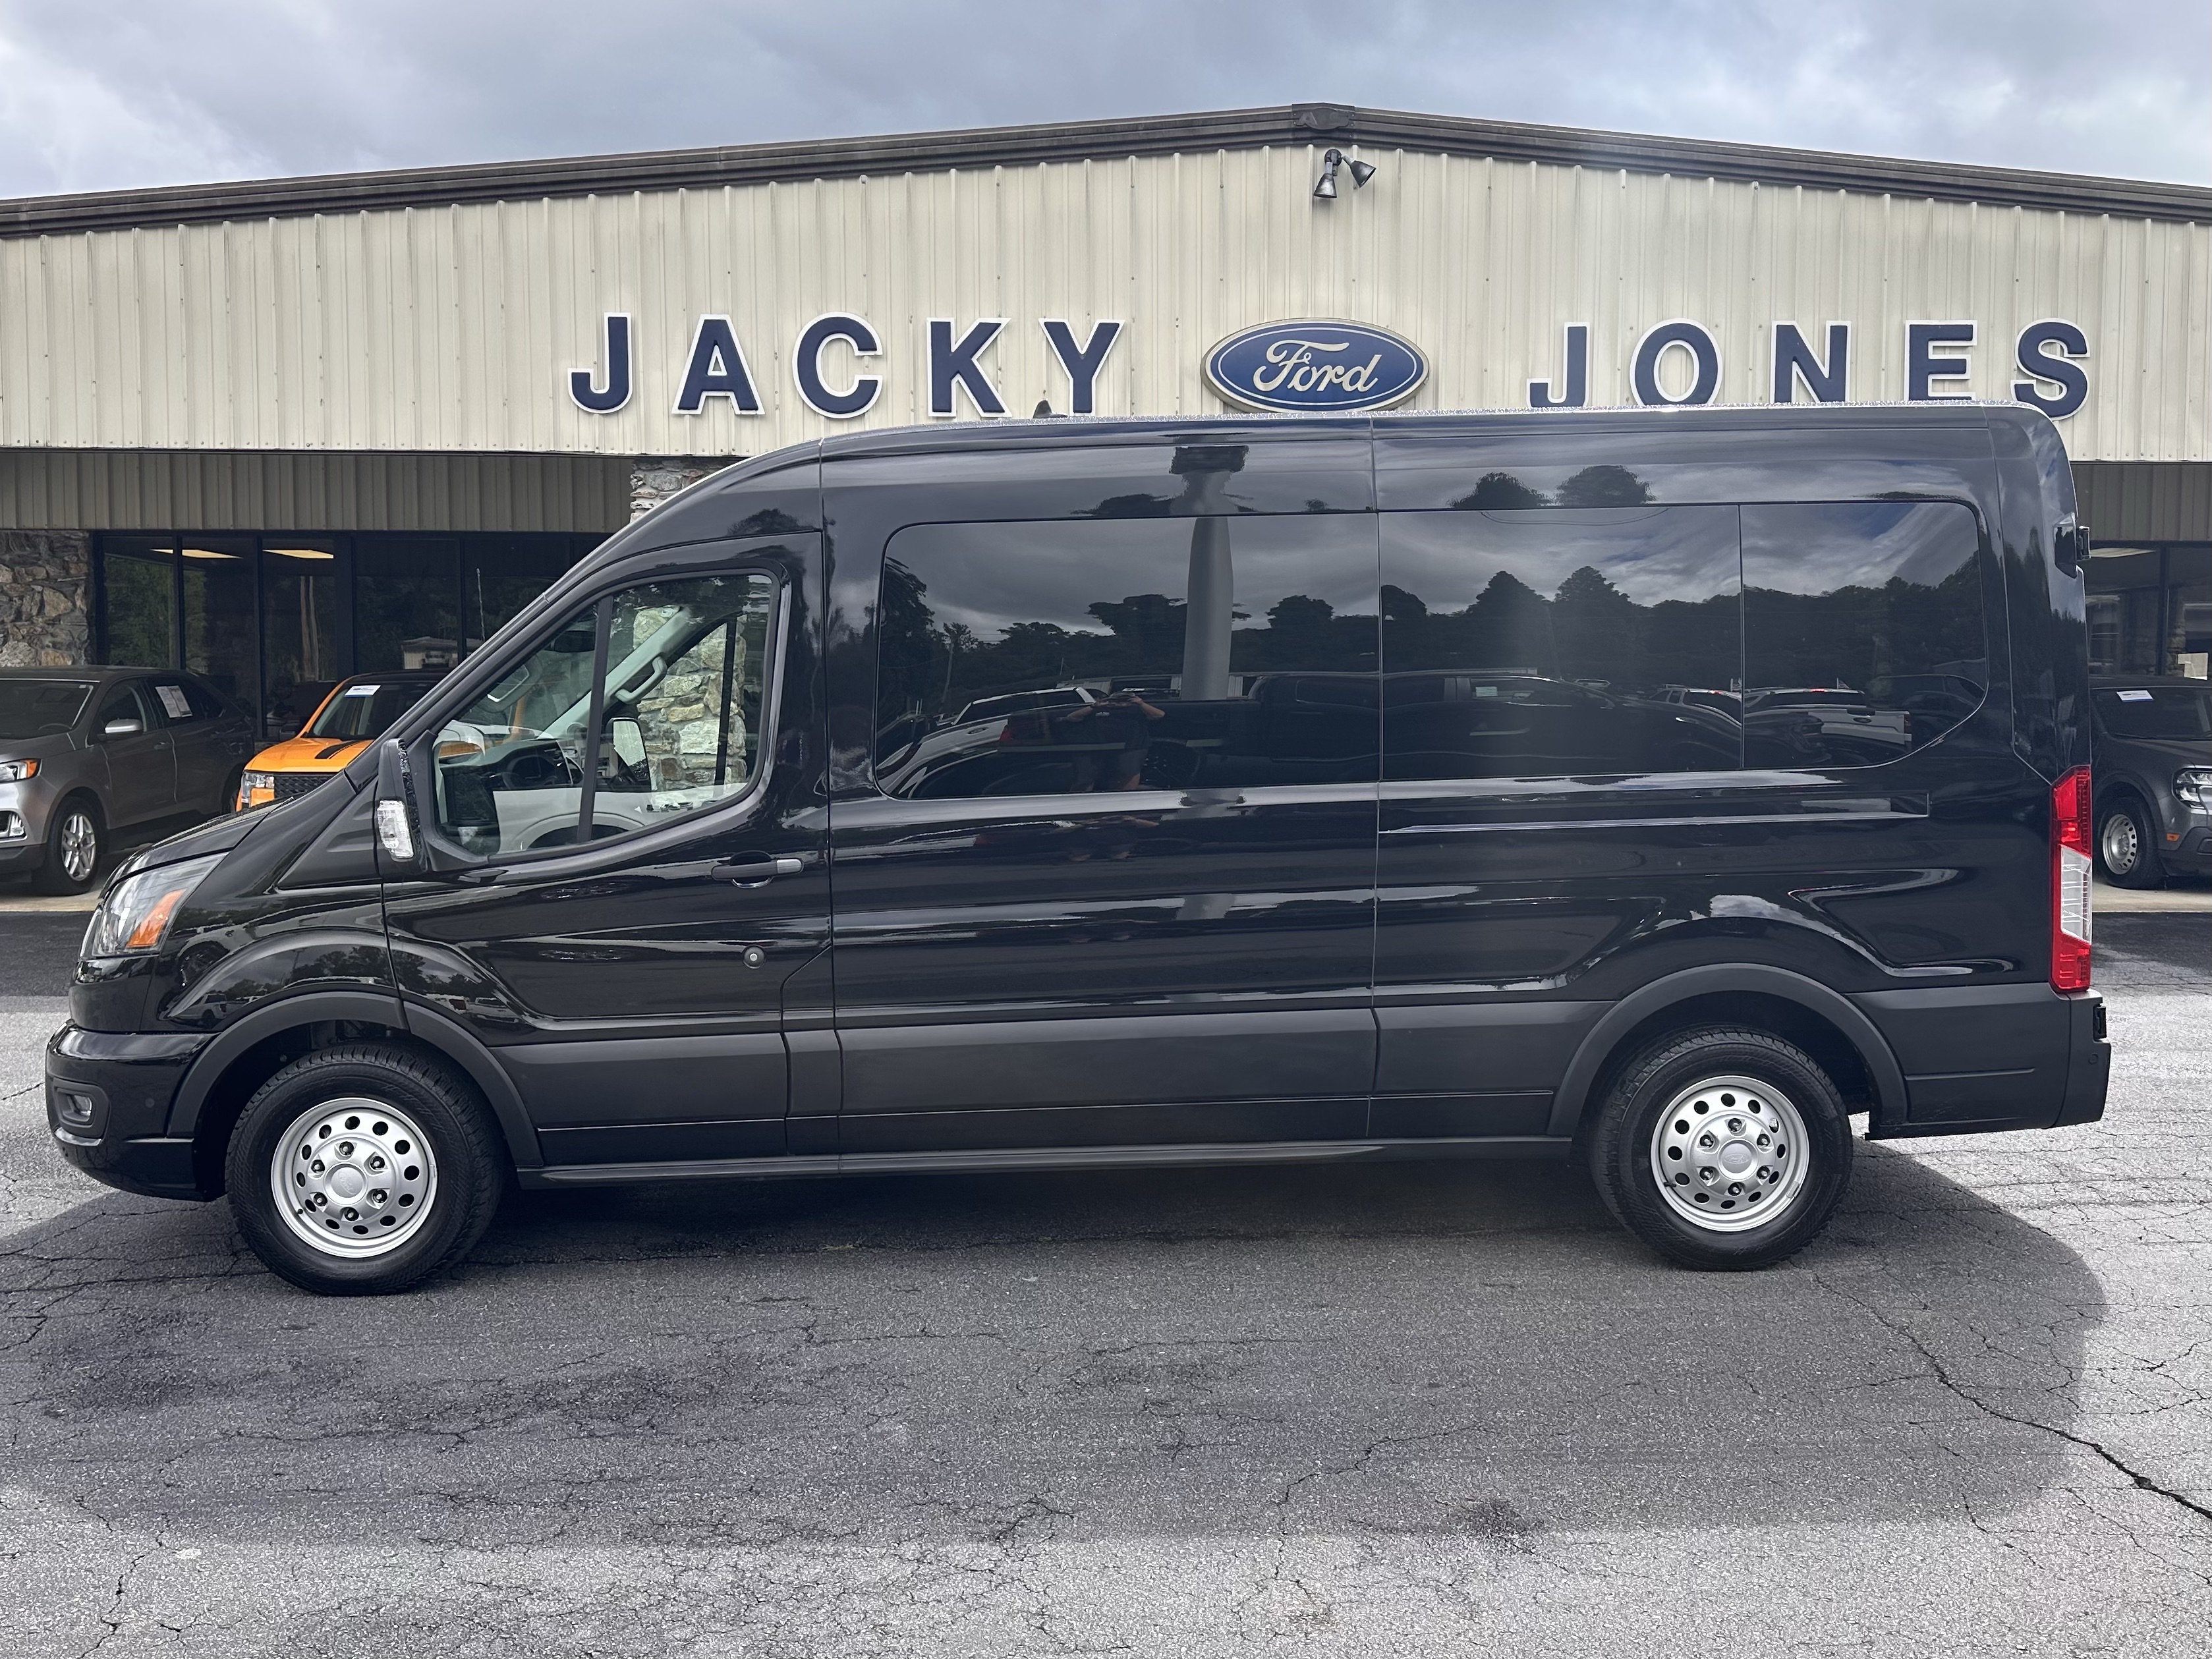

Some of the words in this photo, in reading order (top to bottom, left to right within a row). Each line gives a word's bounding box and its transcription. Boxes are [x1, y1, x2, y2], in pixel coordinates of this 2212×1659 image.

[567, 312, 1125, 418] JACKY
[1526, 318, 2091, 421] JONES
[1253, 339, 1382, 392] Ford
